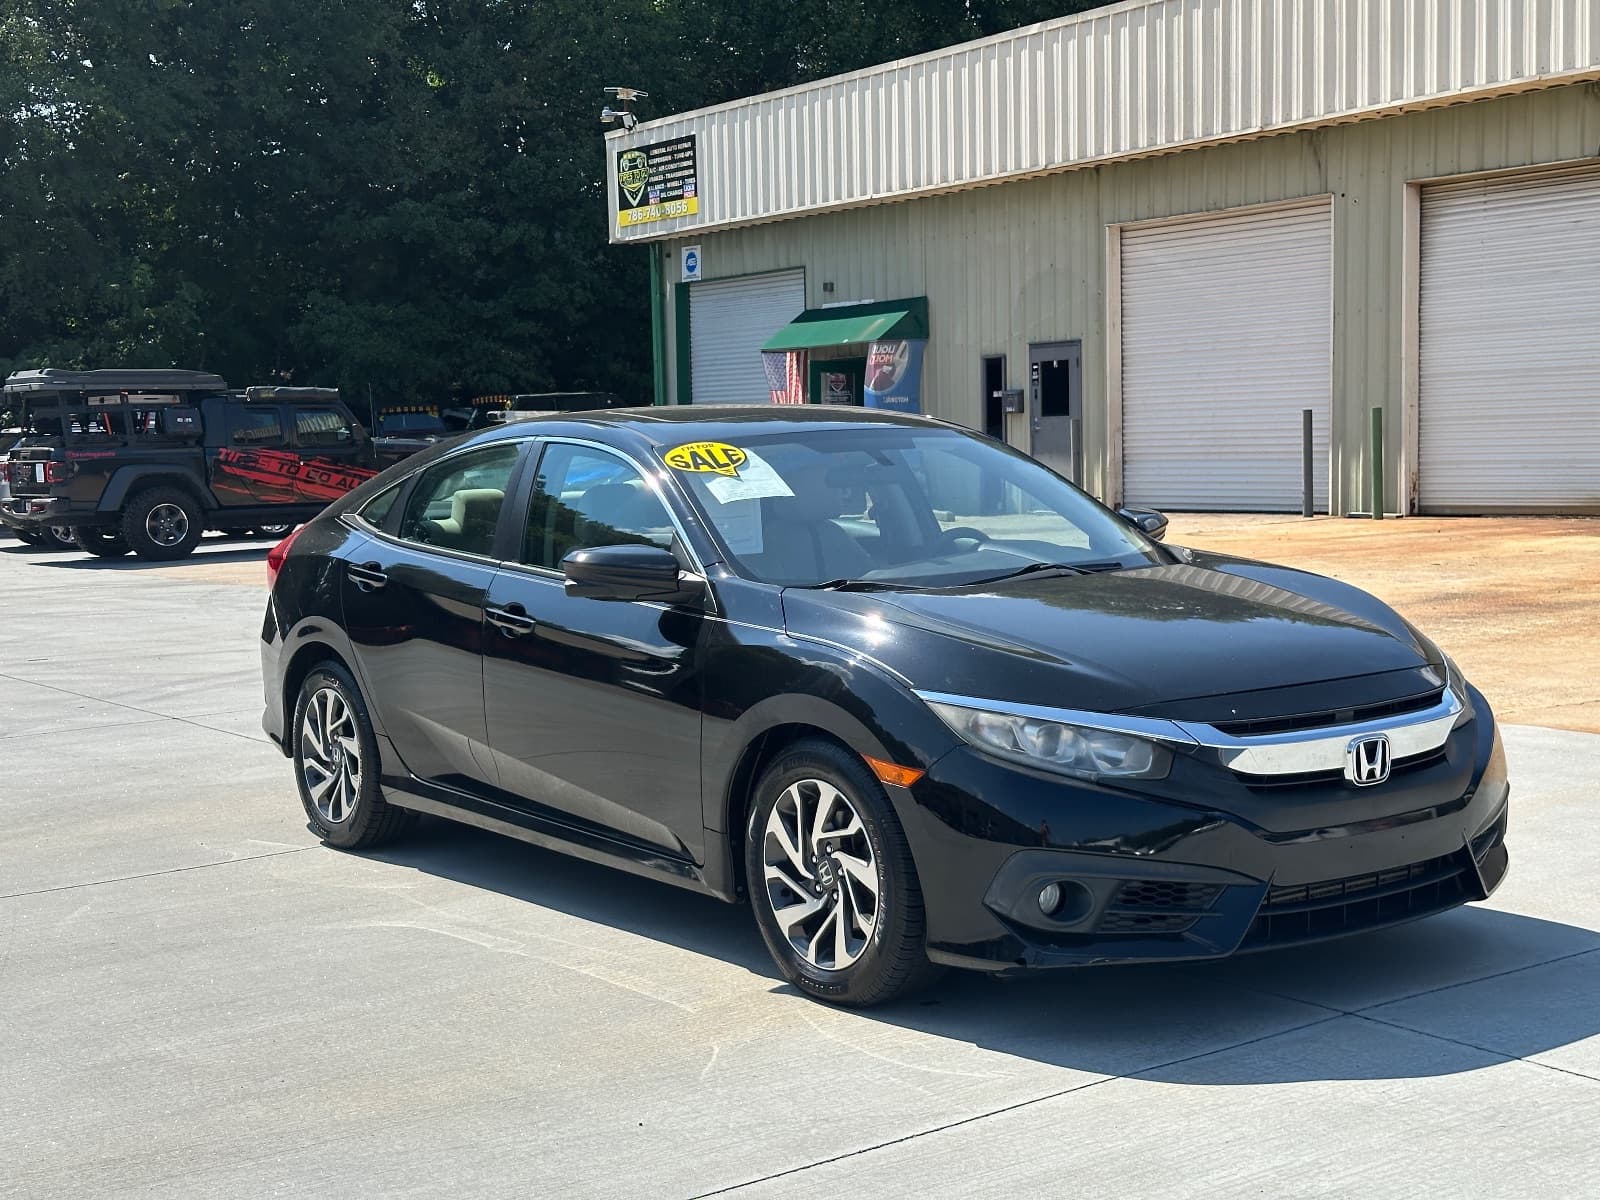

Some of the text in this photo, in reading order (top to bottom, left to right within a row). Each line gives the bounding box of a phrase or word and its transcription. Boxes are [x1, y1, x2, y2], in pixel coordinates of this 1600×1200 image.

[628, 201, 688, 222] 786-740-8056
[219, 448, 269, 470] TIS
[277, 460, 299, 475] TO
[670, 449, 742, 470] SALE
